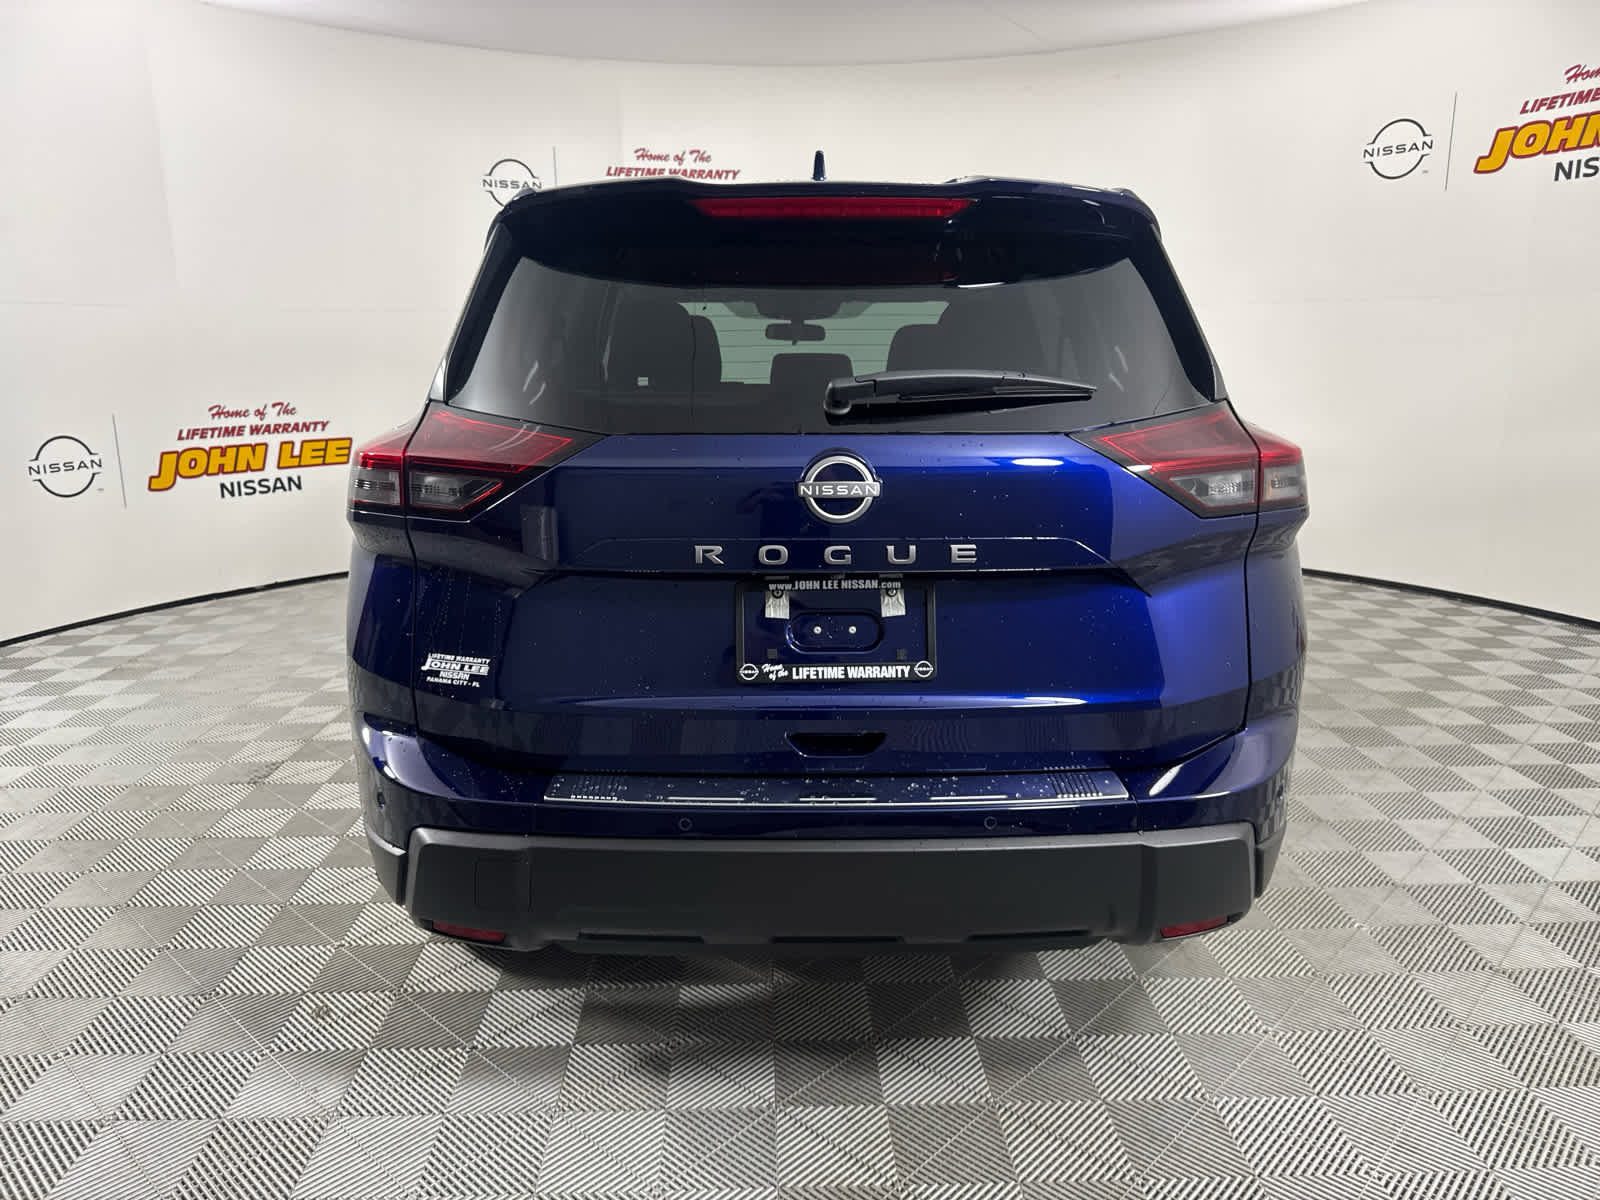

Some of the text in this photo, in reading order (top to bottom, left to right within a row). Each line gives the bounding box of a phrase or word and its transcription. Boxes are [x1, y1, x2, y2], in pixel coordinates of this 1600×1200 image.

[1520, 88, 1600, 114] LIFETIME
[634, 147, 712, 166] Home of The
[1363, 139, 1434, 160] NISSAN
[606, 166, 740, 180] LIFETIME WARRANTY
[1554, 156, 1600, 182] NIS
[482, 178, 542, 189] NISSAN
[208, 401, 297, 421] Home of The
[176, 420, 330, 442] LIFETIME WARRANTY
[28, 457, 102, 476] NISSAN
[147, 437, 352, 492] JOHN LEE
[220, 475, 303, 499] NISSAN
[800, 484, 877, 496] NISSAN
[694, 544, 978, 565] ROGUE
[768, 579, 902, 591] www.JOHN LEE NISSAN.com
[421, 658, 490, 674] JOHN LEE
[792, 665, 911, 680] LIFETIME WARRANTY
[439, 671, 470, 681] NISSAN
